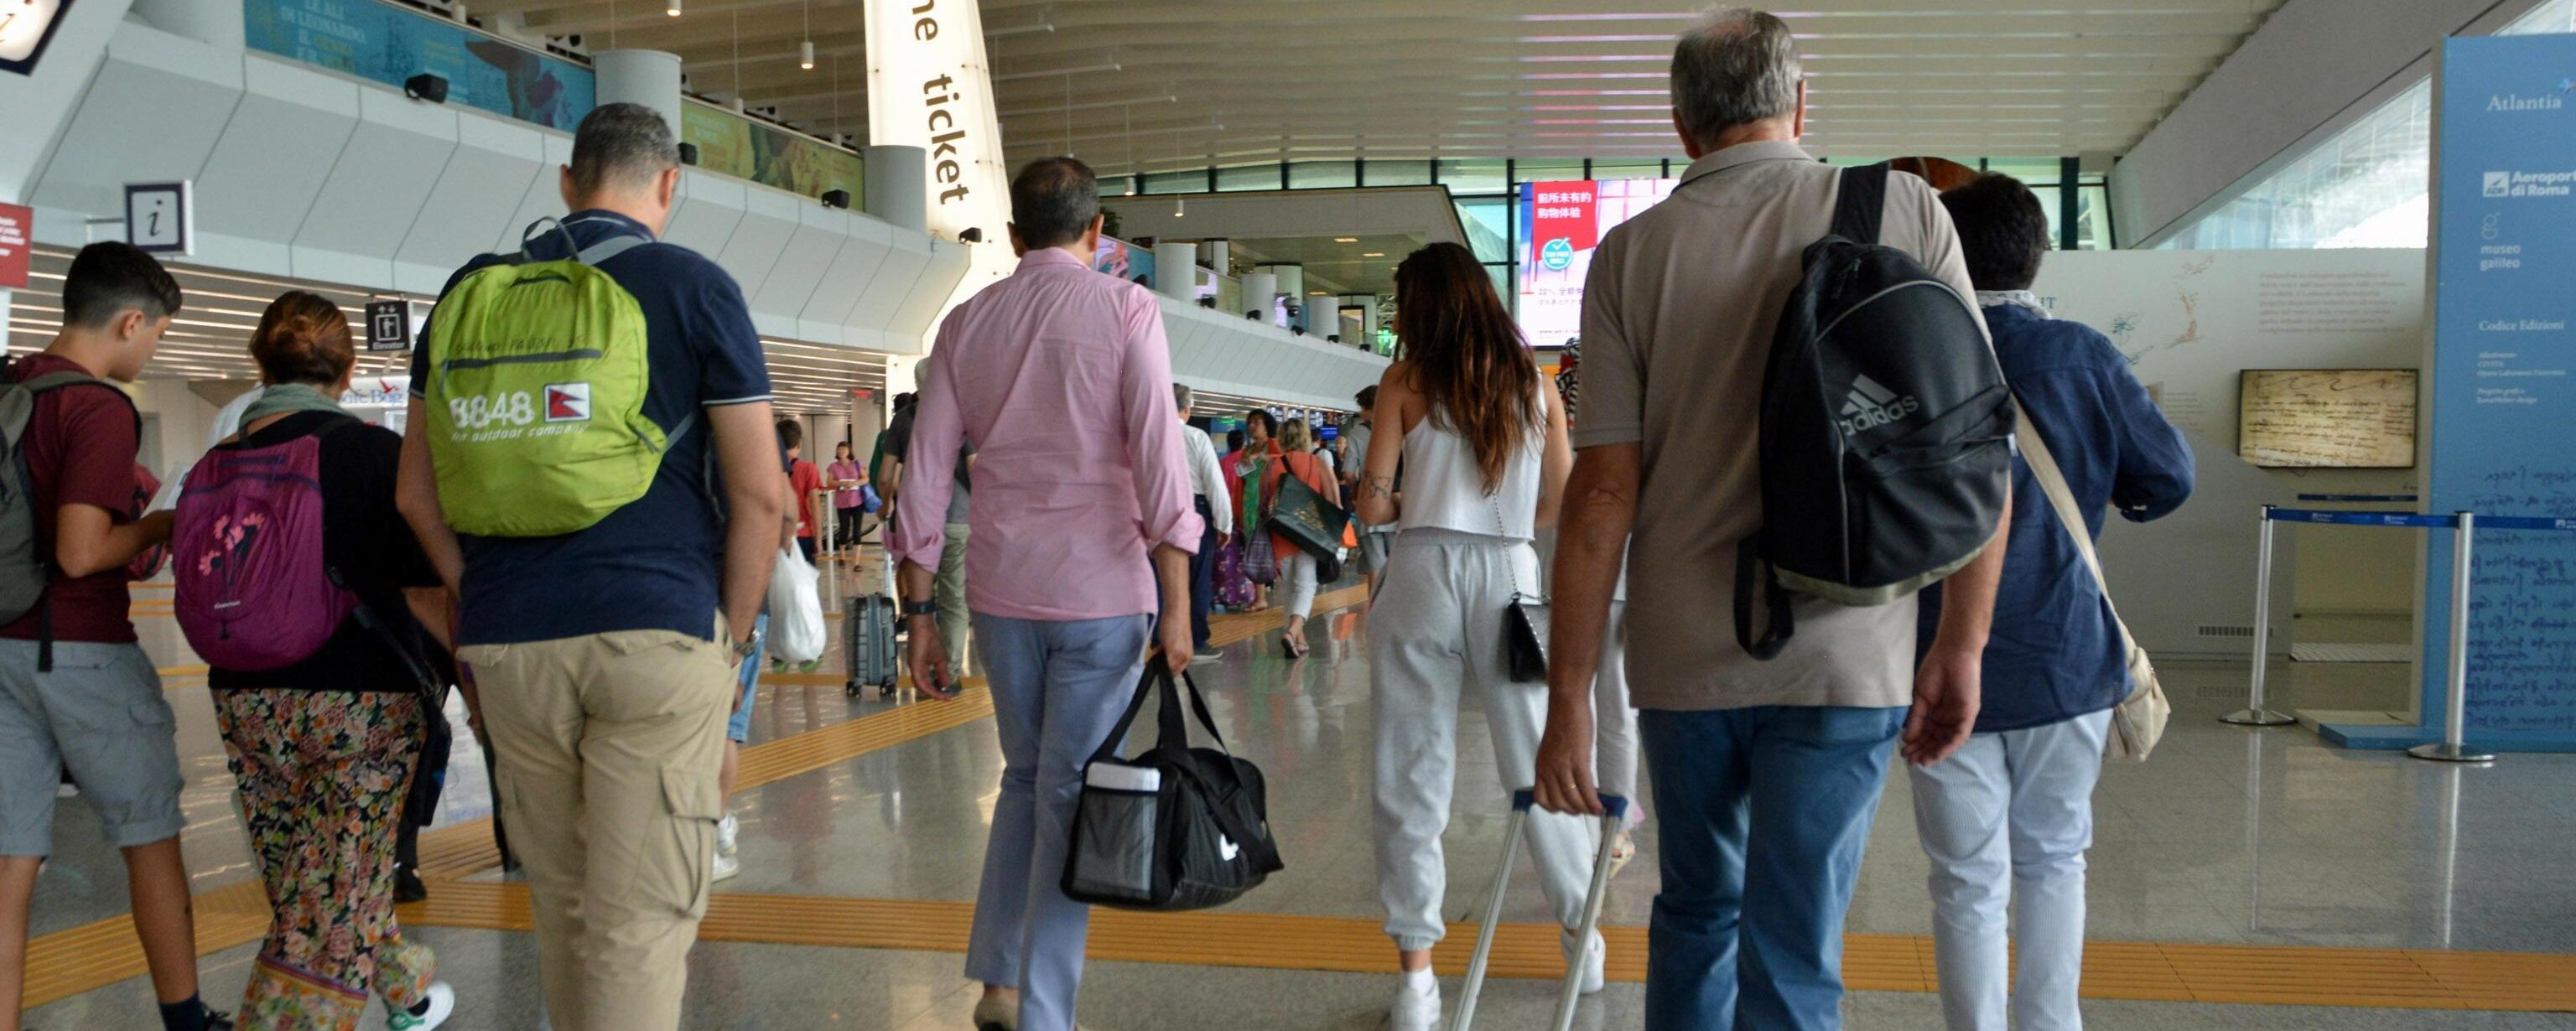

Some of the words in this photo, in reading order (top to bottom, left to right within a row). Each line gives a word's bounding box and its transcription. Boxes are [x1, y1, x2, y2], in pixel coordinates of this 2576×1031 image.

[2486, 94, 2563, 111] Atlantia
[923, 74, 970, 205] ticket
[2511, 184, 2526, 197] di
[2527, 184, 2570, 197] Roma
[2480, 246, 2521, 255] museo
[2480, 258, 2521, 272] galileo
[449, 391, 535, 429] 8848
[1840, 396, 1919, 436] adidas
[472, 428, 522, 443] outdoor
[527, 424, 589, 437] company
